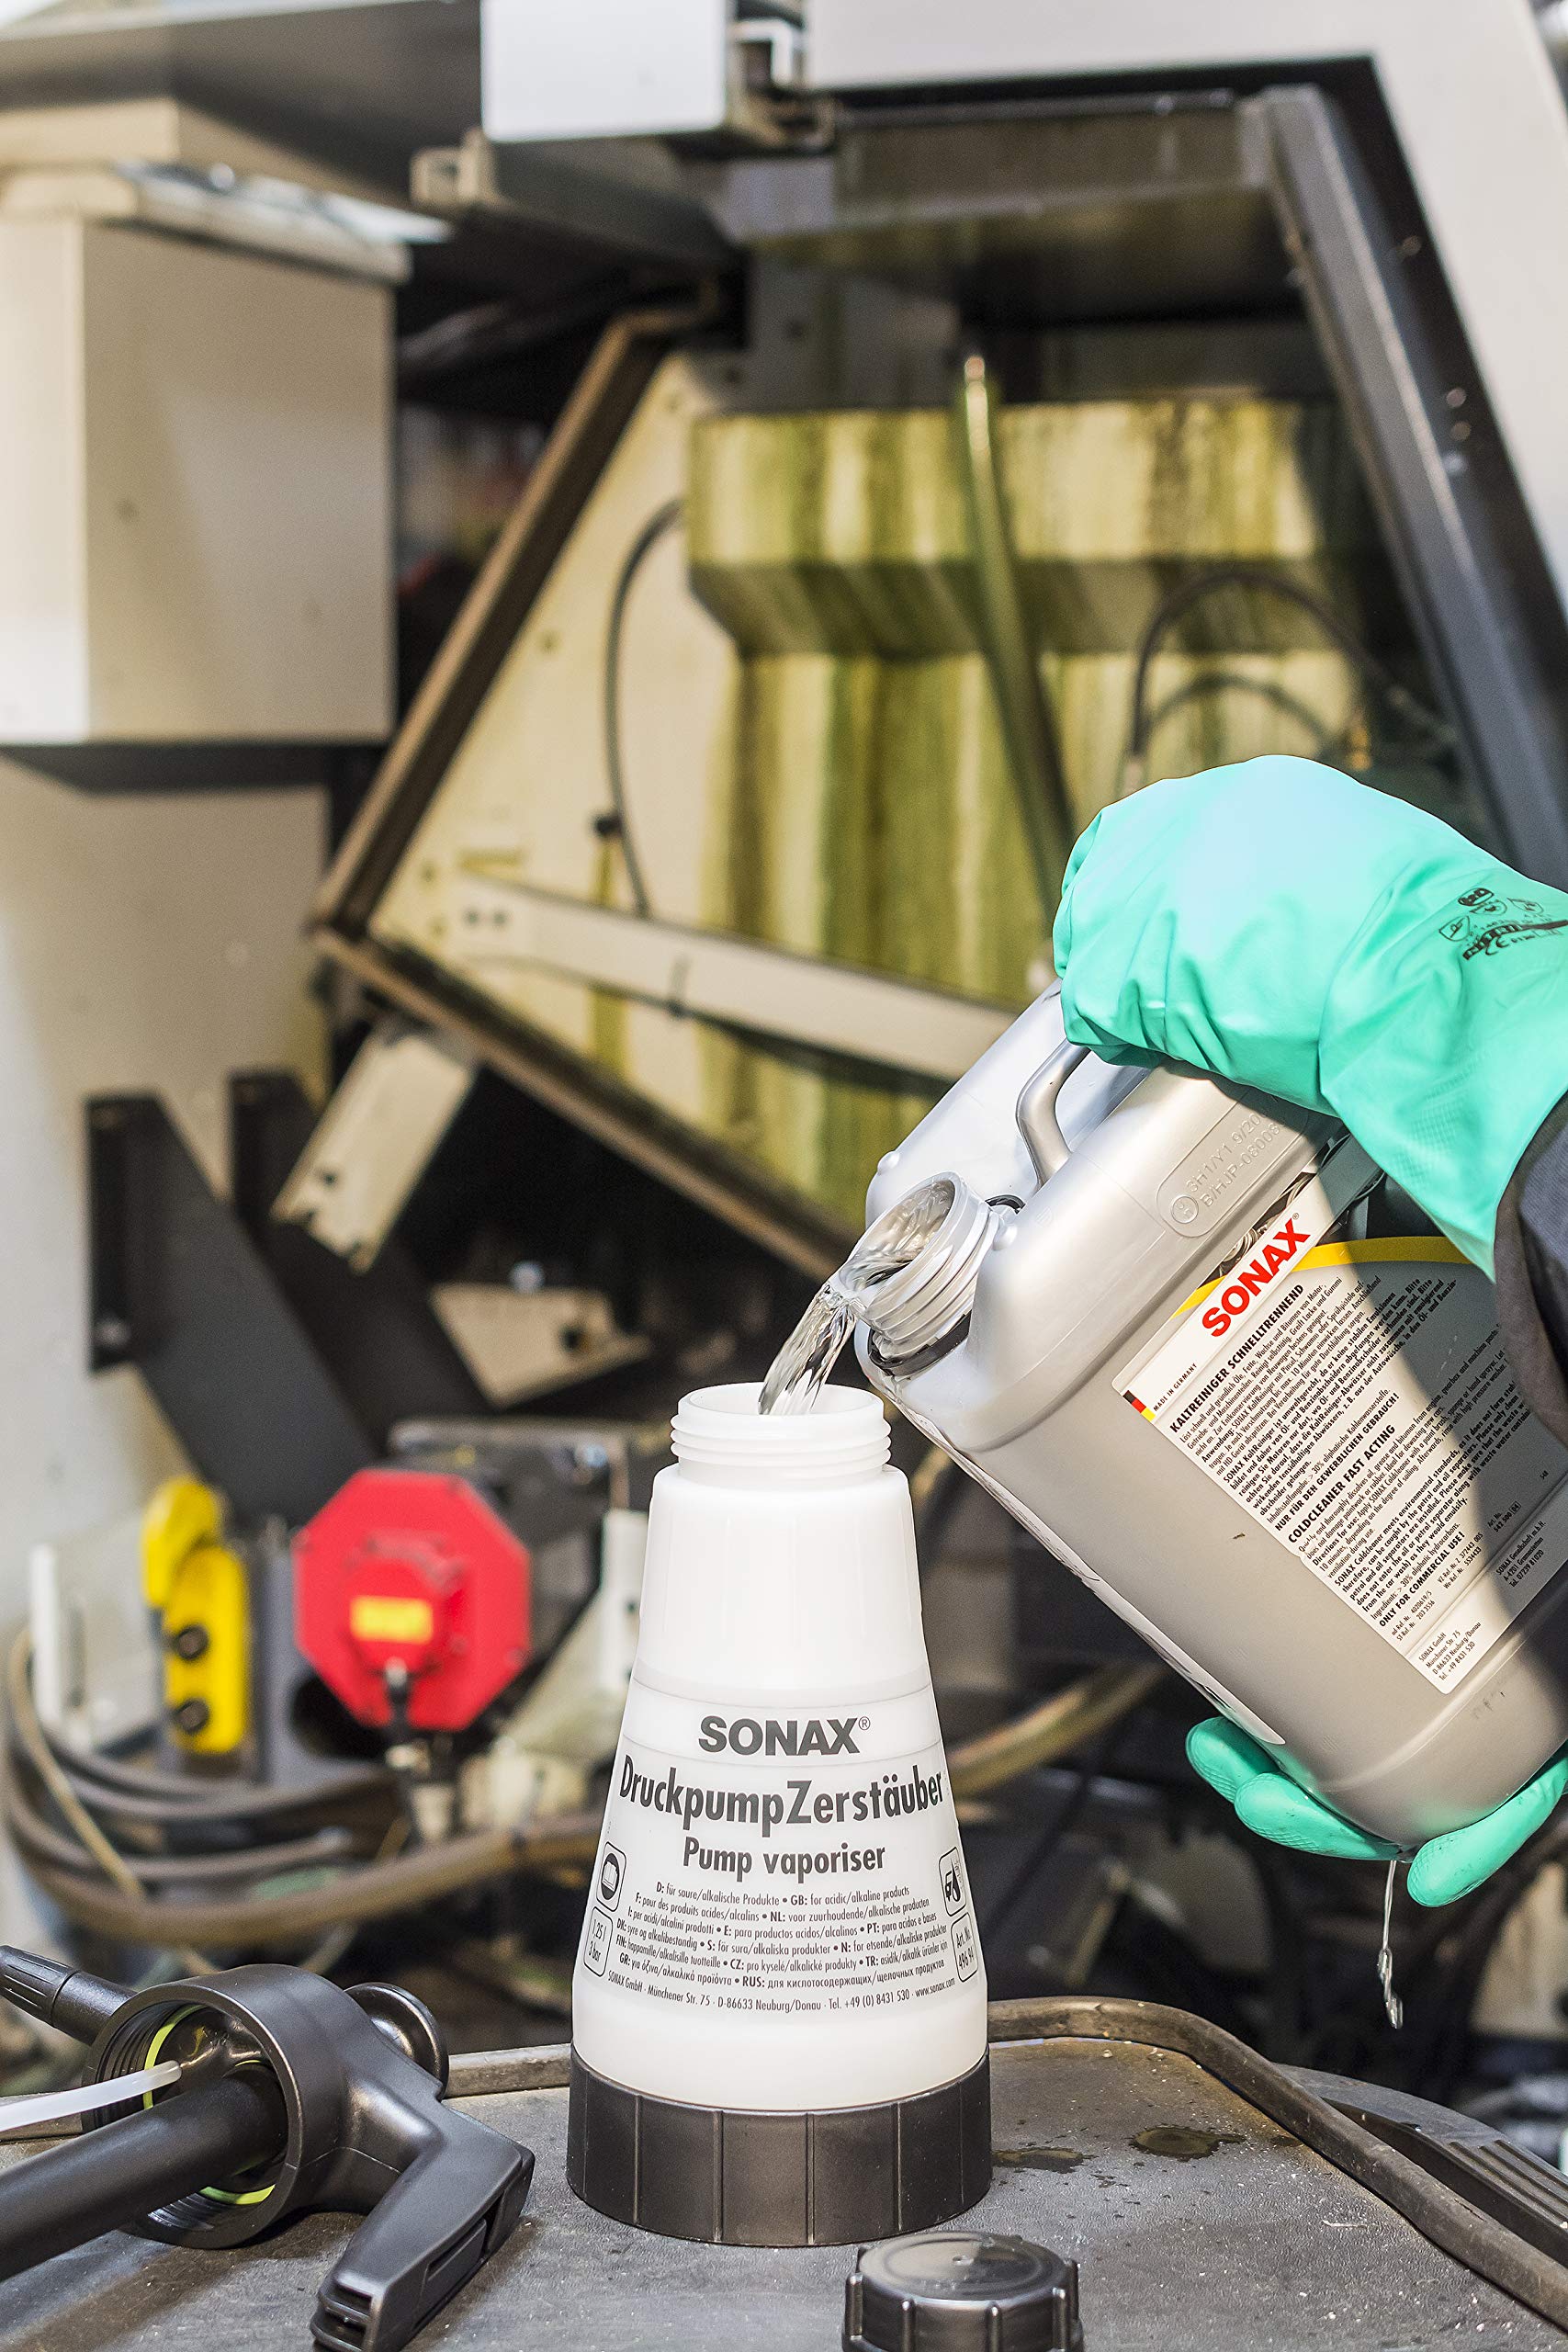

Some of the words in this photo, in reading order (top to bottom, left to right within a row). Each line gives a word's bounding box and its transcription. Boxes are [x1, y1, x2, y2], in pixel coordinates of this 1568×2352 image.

[1169, 1367, 1230, 1432] KALTREINIGER
[1227, 1284, 1303, 1369] SCHNELLTRENNEND
[1190, 1413, 1207, 1432] schnell
[1205, 1403, 1215, 1416] und
[1213, 1382, 1235, 1408] gründlich
[1242, 1360, 1258, 1373] Fette,
[1254, 1340, 1274, 1359] Wachse
[1272, 1328, 1283, 1340] und
[1280, 1309, 1301, 1330] Bitumen
[1299, 1299, 1310, 1310] von
[1153, 1396, 1168, 1411] MADE
[1173, 1363, 1196, 1388] GERMANY
[1223, 1460, 1245, 1483] SONAX
[1242, 1427, 1275, 1462] KaltReiniger
[1272, 1419, 1282, 1428] ist
[1281, 1377, 1321, 1419] umweltgerecht,
[1319, 1368, 1328, 1377] da
[1326, 1361, 1334, 1369] er
[1331, 1345, 1348, 1362] keine
[1348, 1323, 1368, 1346] stabilen
[1365, 1292, 1395, 1324] Emulsionen
[1274, 1514, 1291, 1531] NUR
[1289, 1499, 1304, 1515] FÜR
[1302, 1484, 1317, 1500] DEN
[1315, 1432, 1363, 1485] GEWERBLICHEN
[1361, 1392, 1399, 1433] GEBRAUCH!
[1259, 1486, 1286, 1515] abscheider
[1286, 1461, 1311, 1488] gelangen.
[1288, 1481, 1346, 1543] COLDCLEANER
[1342, 1457, 1364, 1482] FAST
[1363, 1424, 1394, 1460] ACTING
[1361, 1598, 1377, 1611] from
[1375, 1588, 1386, 1598] the
[1385, 1577, 1394, 1588] car
[1393, 1559, 1411, 1578] wash)
[1409, 1553, 1417, 1561] as
[1416, 1539, 1430, 1553] they
[1427, 1518, 1445, 1539] would
[1444, 1497, 1467, 1521] emulsify.
[1495, 1557, 1512, 1575] SONAX
[1516, 1563, 1530, 1579] 07239
[1528, 1549, 1543, 1566] 81020
[1379, 1607, 1396, 1626] ONLY
[1394, 1593, 1410, 1609] FOR
[1408, 1549, 1450, 1593] COMMERCIAL
[1447, 1531, 1464, 1549] USE!
[1418, 1645, 1434, 1661] SONAX
[1431, 1632, 1446, 1646] GmbH
[1449, 1622, 1481, 1656] Neuburg/Donau
[1451, 1630, 1461, 1638] 75
[1448, 1661, 1456, 1672] +49
[1454, 1650, 1467, 1663] 8431
[1464, 1641, 1475, 1652] 530
[619, 1755, 943, 1838] DruckpumpZerstäuber
[683, 1836, 752, 1883] Pump
[763, 1842, 886, 1884] vaporiser
[636, 1892, 641, 1904] F:
[642, 1897, 656, 1908] pour
[658, 1897, 669, 1910] des
[671, 1902, 699, 1917] produits
[701, 1907, 760, 1921] acides/alcalins
[770, 1911, 785, 1922] NL:
[788, 1914, 806, 1922] voor
[808, 1902, 901, 1922] zuurhoudende/alkalische
[902, 1897, 930, 1916] producten
[656, 1881, 665, 1894] D:
[666, 1882, 677, 1896] für
[678, 1888, 740, 1905] saure/alkalische
[743, 1893, 780, 1905] Produkte
[790, 1894, 808, 1906] GB:
[810, 1893, 822, 1905] for
[824, 1888, 881, 1905] acidic/alkaline
[883, 1885, 910, 1900] products
[616, 1917, 627, 1933] DK:
[627, 1924, 638, 1937] syre
[638, 1928, 647, 1940] og
[648, 1928, 698, 1951] alkalibestandig
[707, 1939, 716, 1951] S:
[717, 1939, 728, 1952] för
[731, 1941, 790, 1956] sura/alkaliska
[791, 1942, 831, 1957] produkter
[840, 1941, 852, 1953] N:
[853, 1939, 864, 1952] for
[866, 1929, 923, 1951] etsende/alkaliske
[923, 1923, 947, 1941] produkter
[633, 1909, 642, 1921] per
[644, 1912, 684, 1930] acidi/alcalini
[685, 1921, 715, 1935] prodotti
[724, 1925, 732, 1937] E:
[735, 1928, 752, 1939] para
[754, 1926, 793, 1940] productos
[795, 1924, 858, 1939] acidos/alcalinos
[866, 1923, 880, 1934] PT:
[882, 1923, 897, 1935] para
[898, 1917, 917, 1929] acidos
[922, 1911, 938, 1924] bases
[615, 1934, 627, 1949] FIN:
[691, 1954, 721, 1968] tuotteille
[730, 1958, 745, 1971] CZ:
[746, 1962, 760, 1973] pro
[761, 1958, 823, 1974] kyselé/alkalické
[825, 1957, 857, 1973] produkty
[865, 1955, 879, 1967] TR:
[619, 1951, 631, 1966] GR:
[742, 1975, 765, 1988] RUS:
[607, 1970, 626, 1986] SONAX
[625, 1977, 643, 1993] GmbH
[647, 1984, 684, 2003] Münchener
[685, 1991, 698, 2006] Str.
[700, 1994, 711, 2007] 75
[717, 1996, 753, 2009] D-86633
[755, 1998, 821, 2014] Neuburg/Donau
[829, 1996, 842, 2010] Tel.
[845, 1996, 861, 2008] +49
[863, 1995, 874, 2008] (0)
[875, 1991, 895, 2006] 8431
[897, 1988, 910, 2003] 530
[914, 1976, 956, 1997] www.sonax.com
